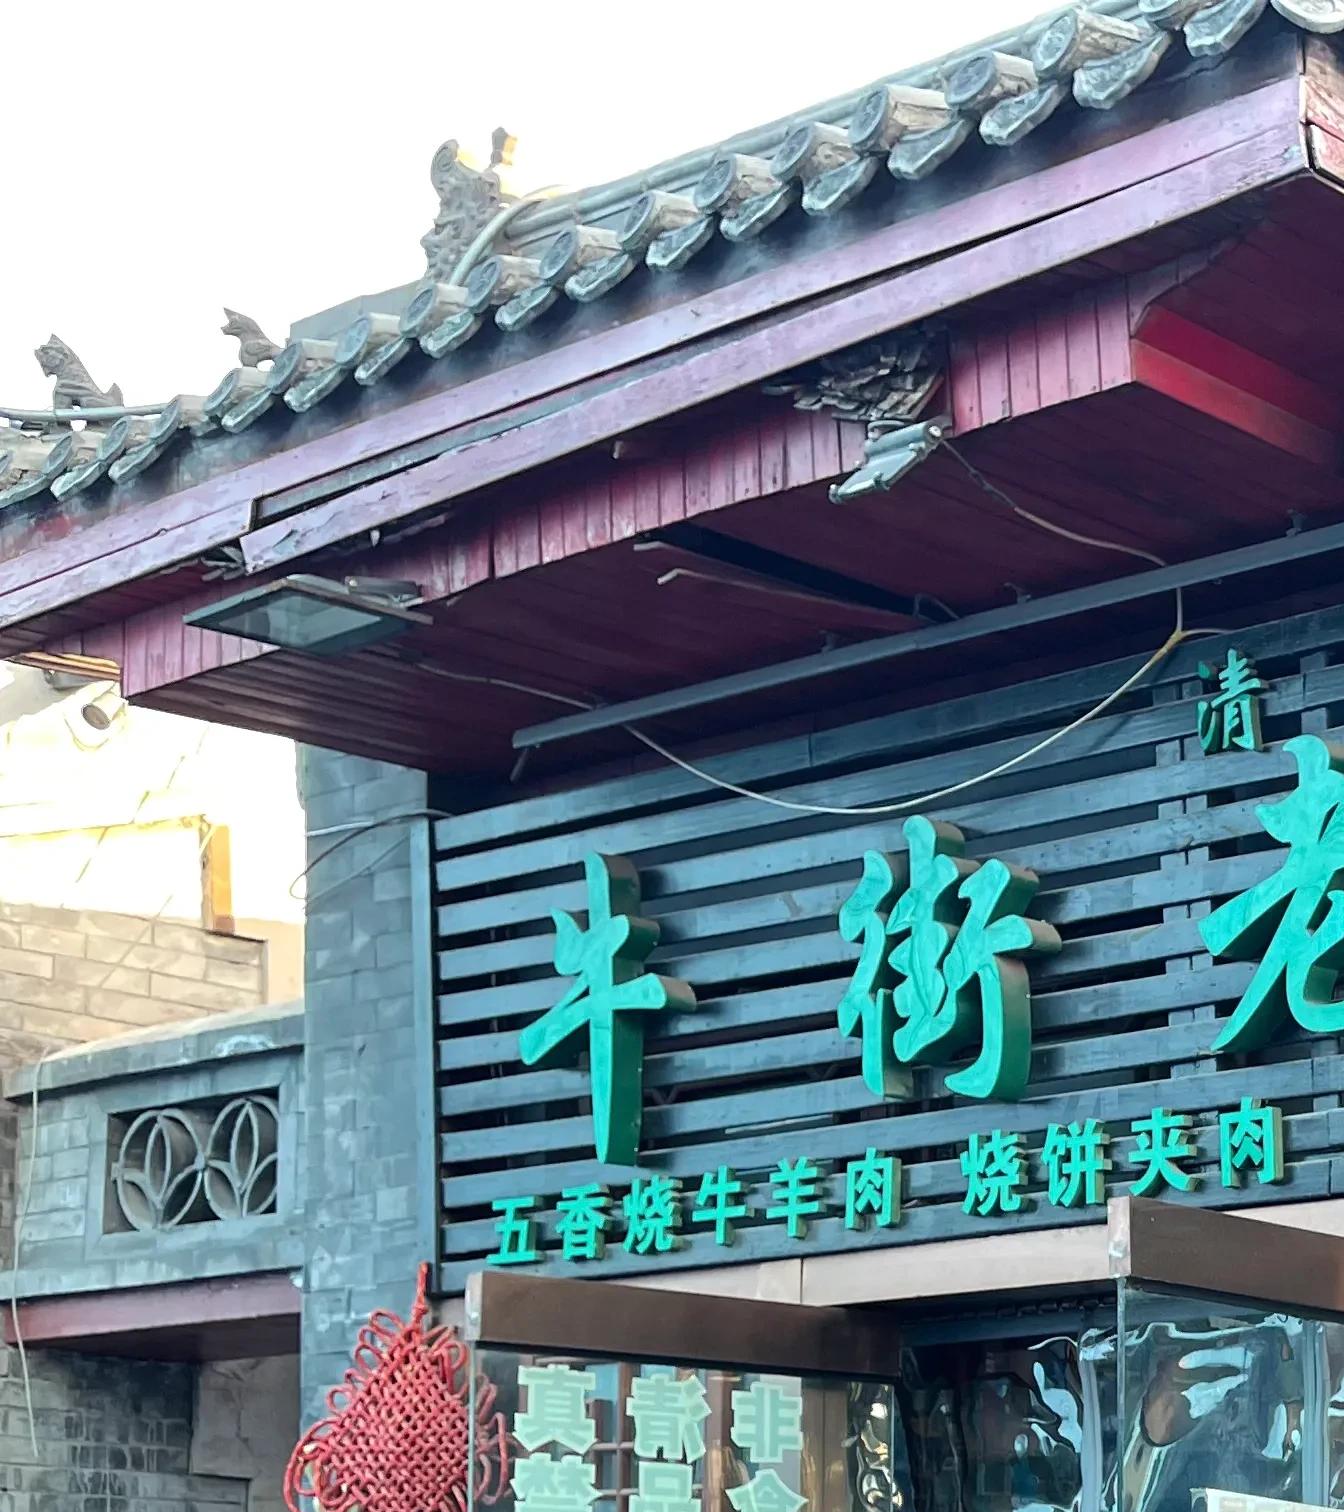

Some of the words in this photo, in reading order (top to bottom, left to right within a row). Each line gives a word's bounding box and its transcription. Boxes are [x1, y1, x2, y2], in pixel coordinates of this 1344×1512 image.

[486, 1147, 902, 1265] 五香烧牛羊肉
[961, 1097, 1284, 1216] 烧饼夹肉
